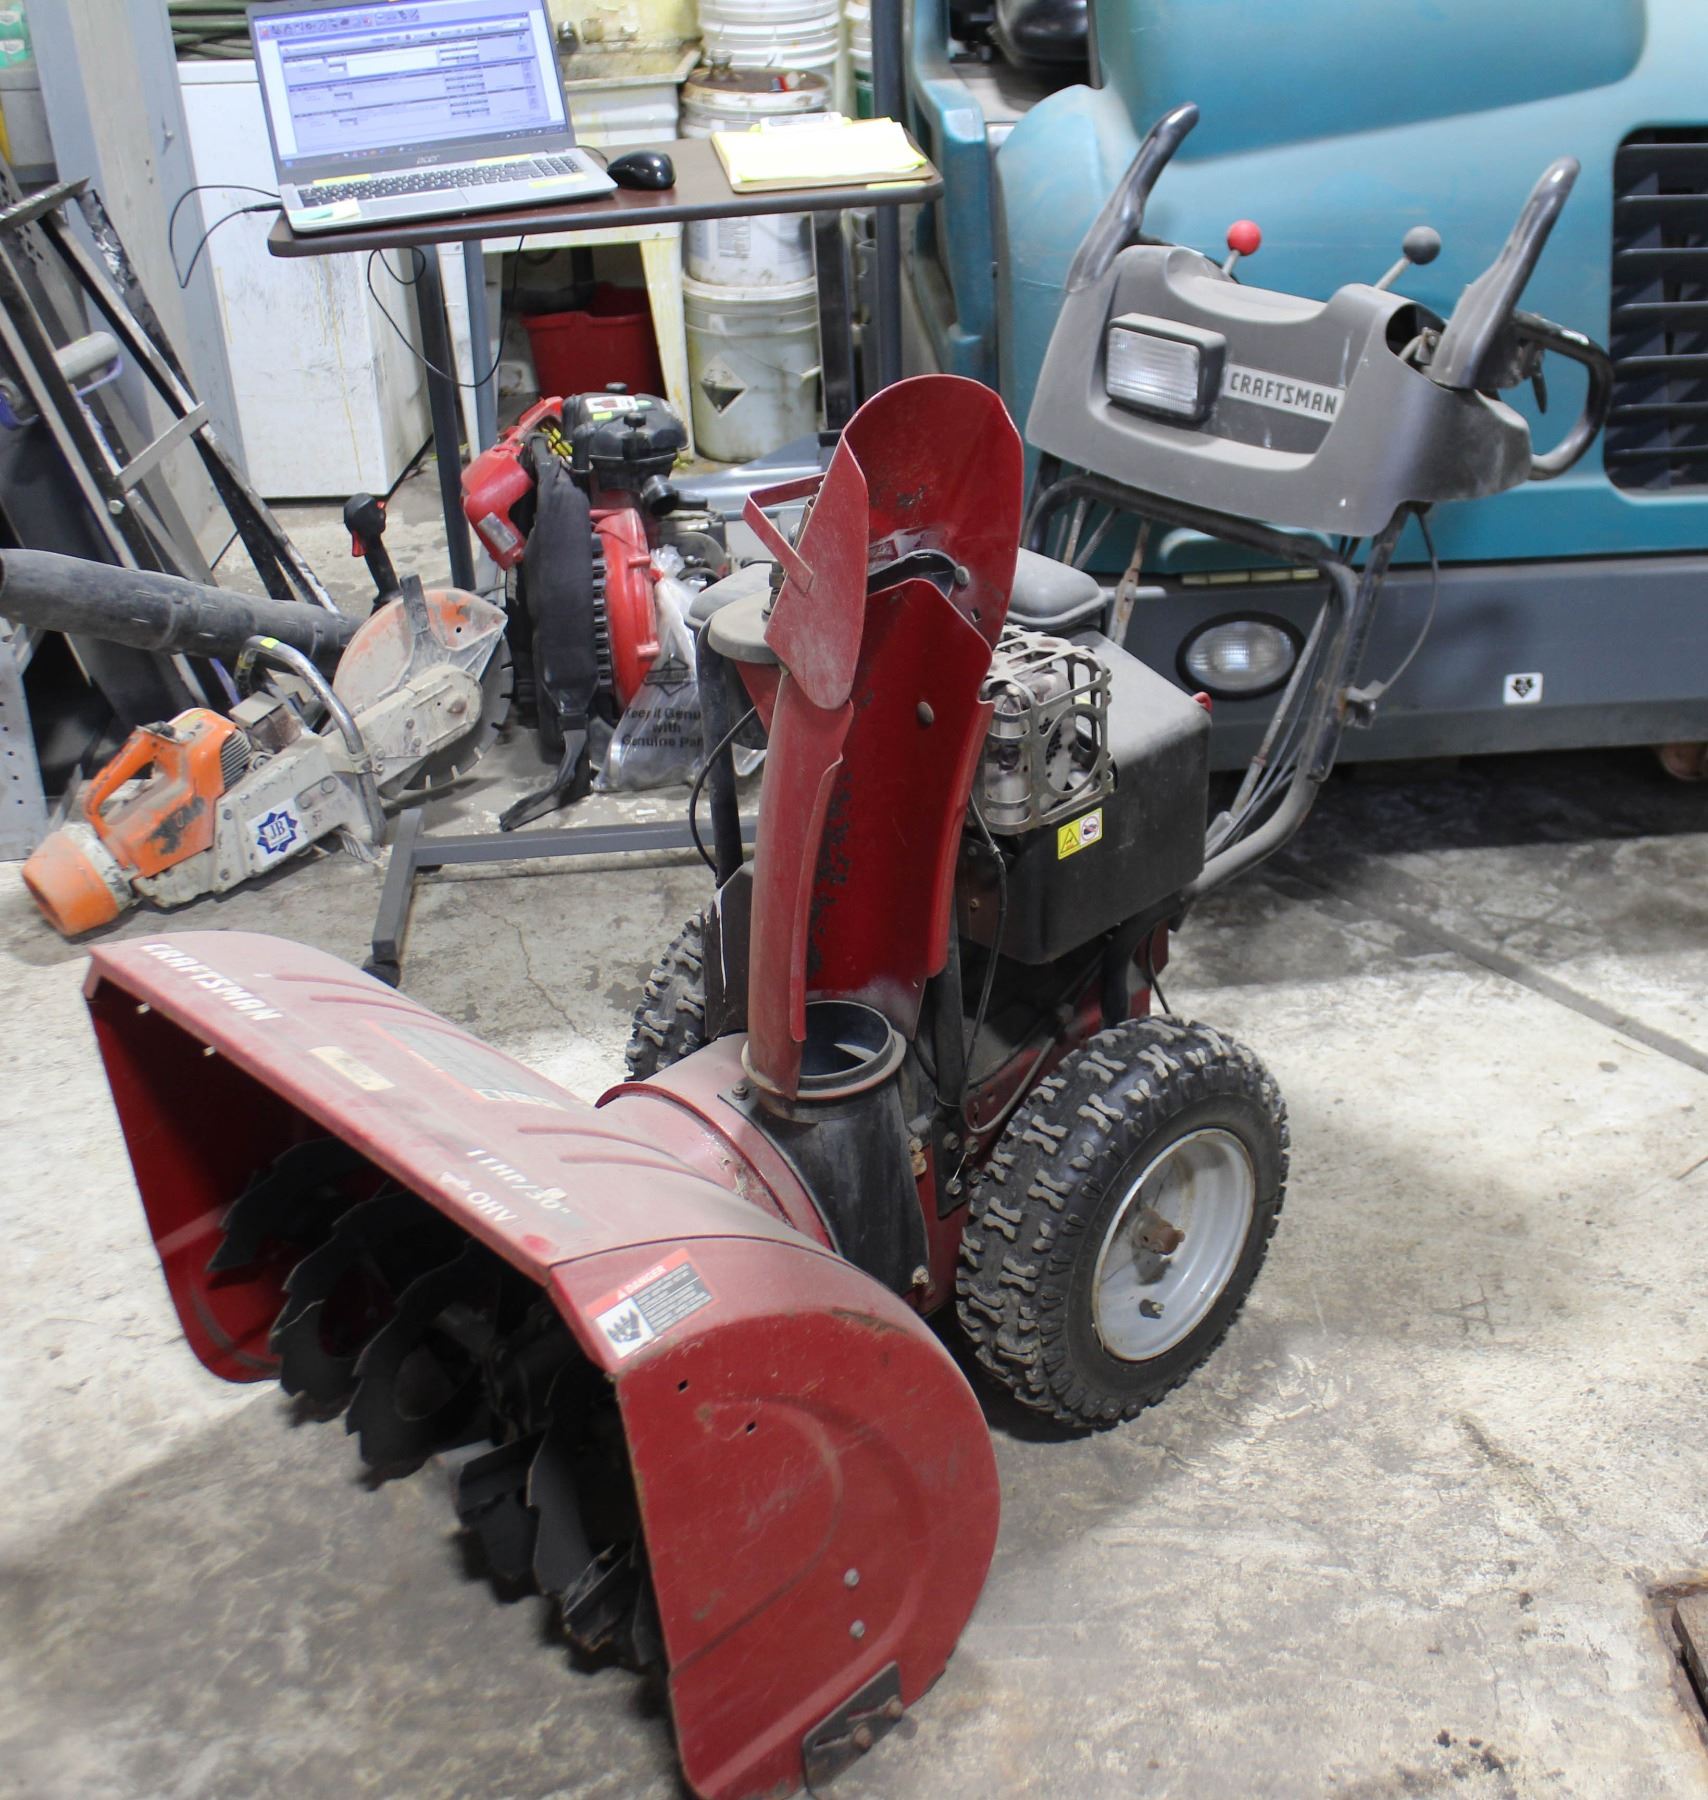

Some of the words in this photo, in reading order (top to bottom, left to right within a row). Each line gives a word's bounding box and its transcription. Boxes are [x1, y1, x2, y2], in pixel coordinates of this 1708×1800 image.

[1230, 372, 1338, 415] CRAFTSMAN
[664, 706, 702, 720] Genu
[653, 720, 681, 733] with
[268, 820, 286, 840] JB
[139, 943, 284, 1021] CRAFTSMAN
[466, 1191, 519, 1222] OHV
